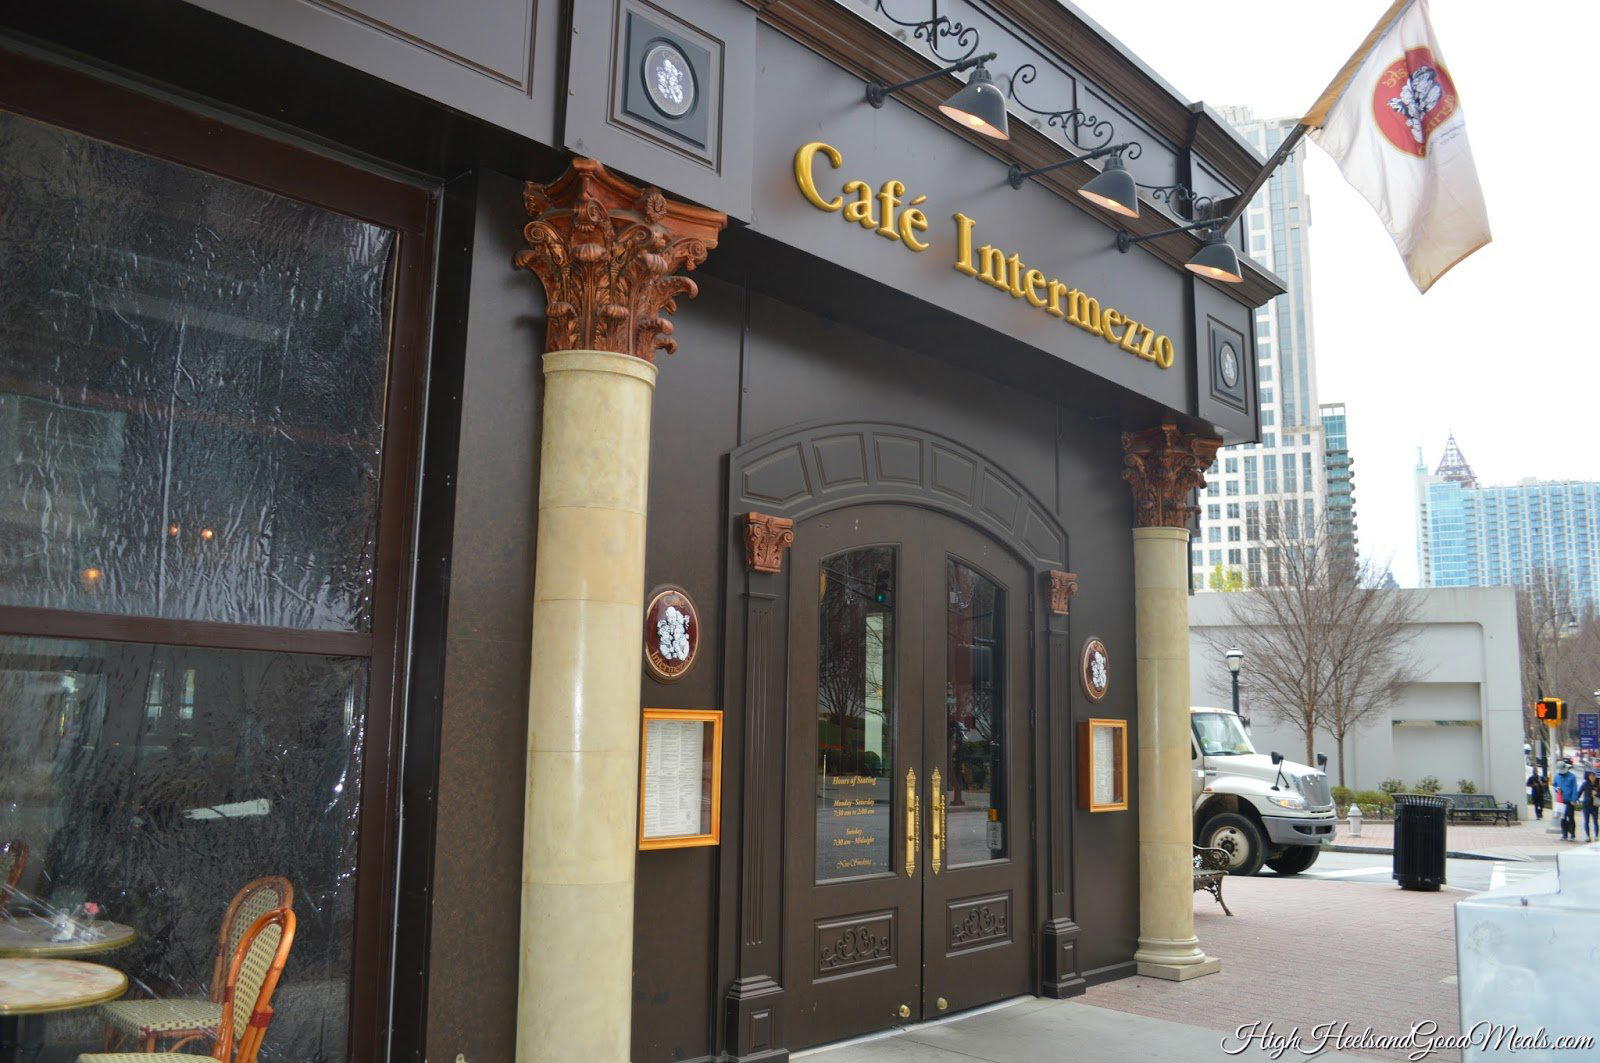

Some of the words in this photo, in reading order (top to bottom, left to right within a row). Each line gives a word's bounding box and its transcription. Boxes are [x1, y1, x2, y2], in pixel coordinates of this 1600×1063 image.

[793, 141, 930, 252] Café
[953, 212, 1175, 370] Intermezzo
[832, 776, 850, 785] Hours
[850, 775, 857, 787] of
[833, 799, 852, 808] Monday
[855, 798, 875, 807] Saturday
[845, 827, 863, 836] Sunday
